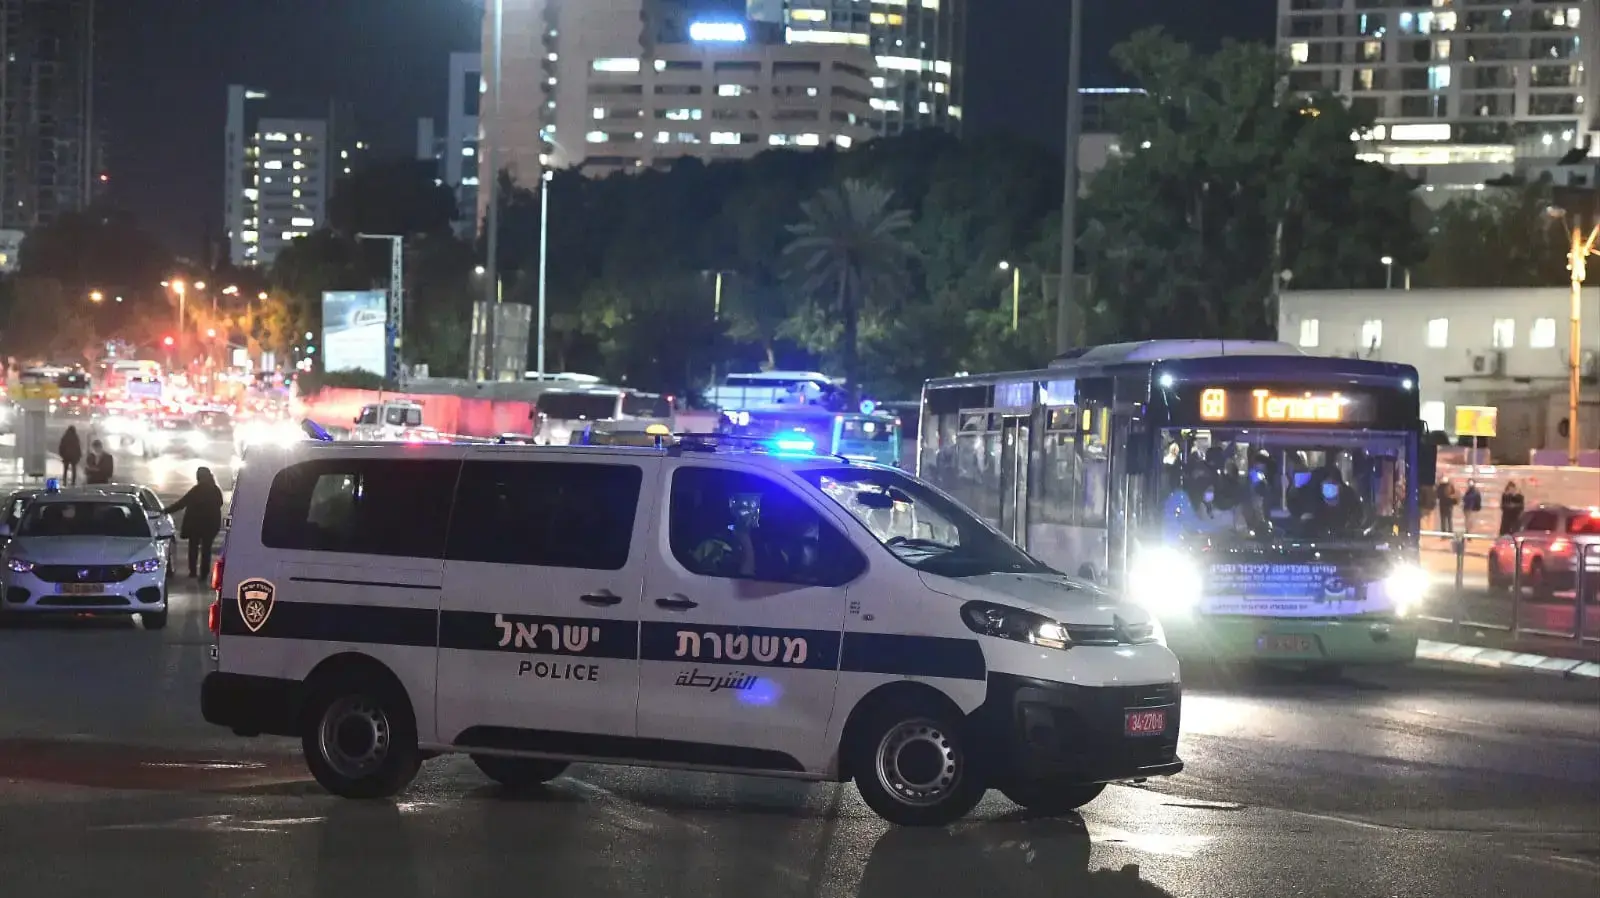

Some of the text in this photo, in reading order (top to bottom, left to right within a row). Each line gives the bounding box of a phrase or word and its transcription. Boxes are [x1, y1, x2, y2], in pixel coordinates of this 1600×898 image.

[1253, 389, 1341, 419] Terminal
[495, 613, 808, 664] משטרת ישראל
[518, 660, 600, 681] POLICE
[674, 668, 758, 692] الشرطة
